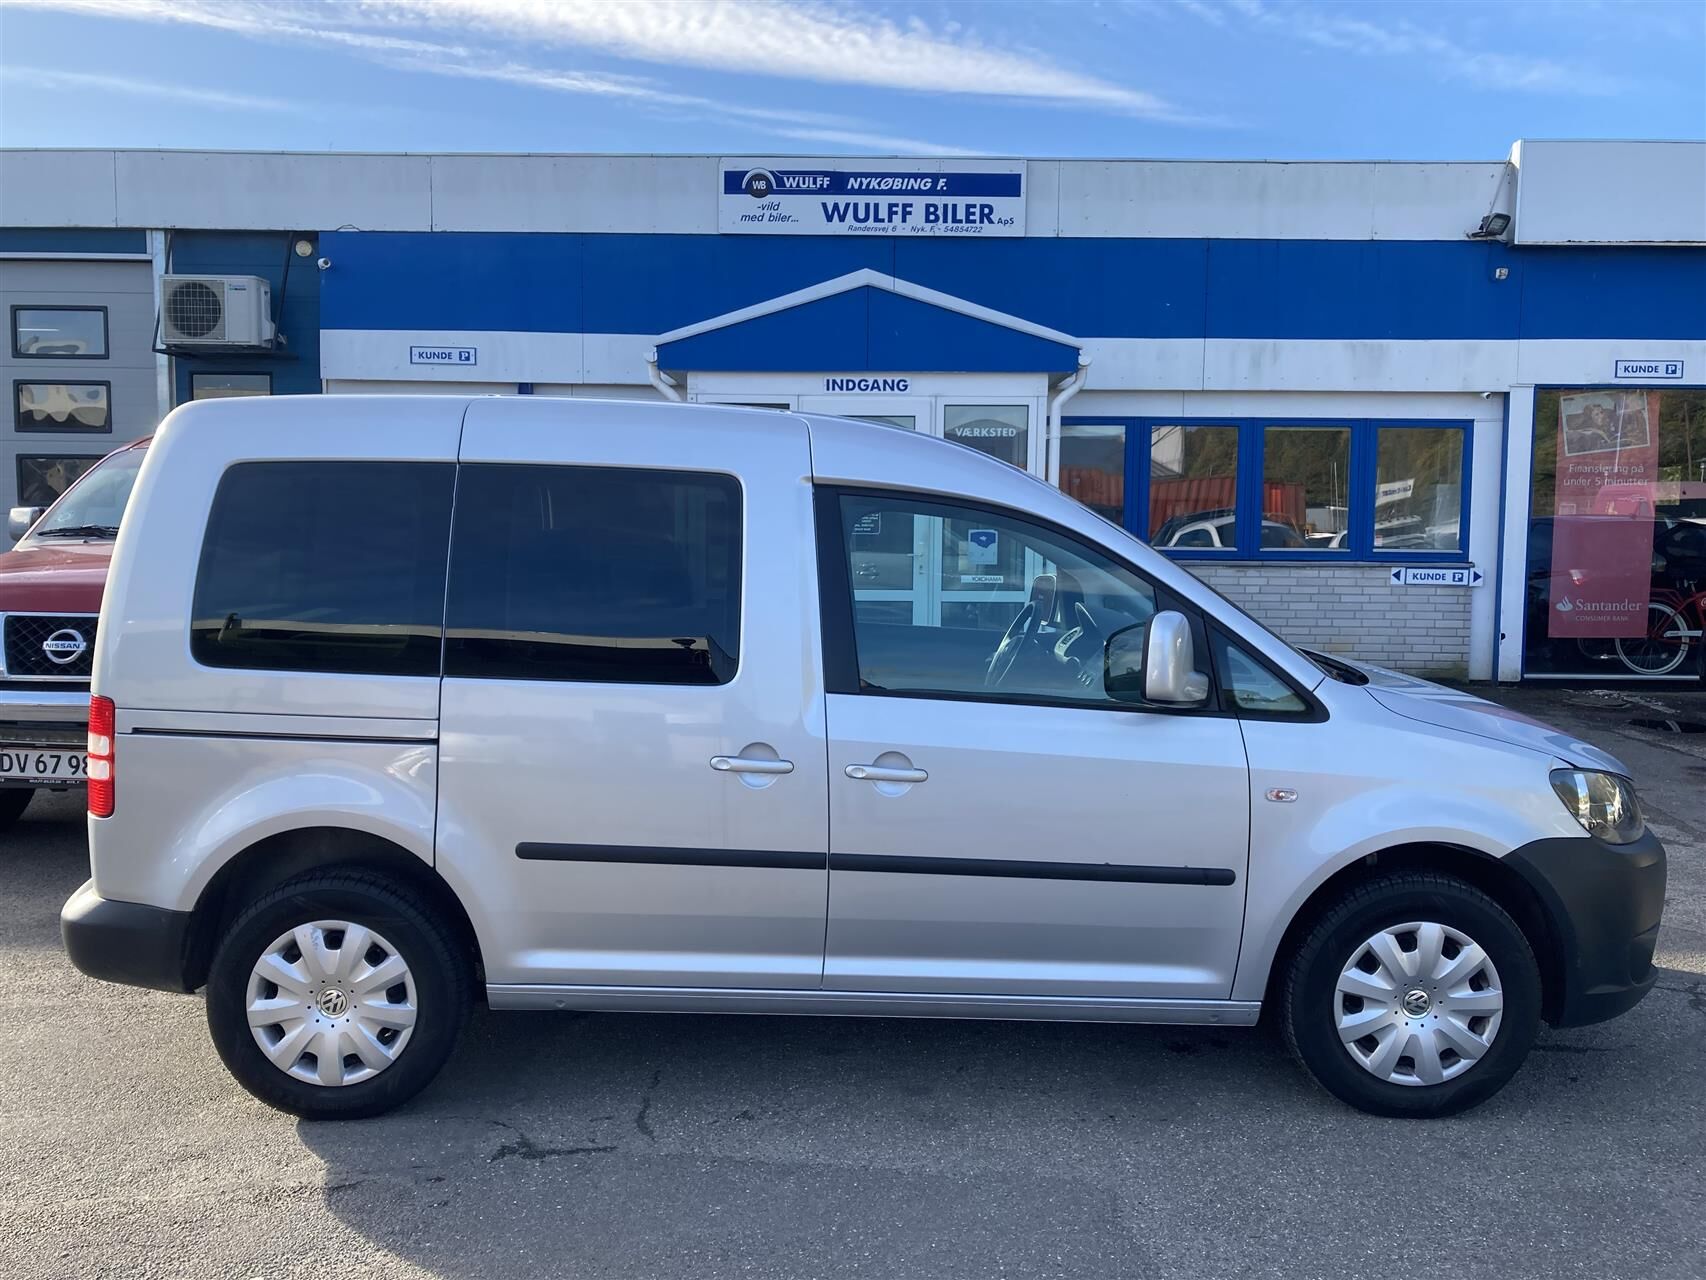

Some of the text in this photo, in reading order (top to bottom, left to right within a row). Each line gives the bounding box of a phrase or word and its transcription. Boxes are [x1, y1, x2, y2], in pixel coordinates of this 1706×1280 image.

[752, 180, 767, 190] WB
[783, 176, 831, 189] WULFF
[847, 177, 948, 191] NYKØBING F.
[757, 202, 780, 211] -vild
[740, 213, 765, 222] med
[821, 202, 1015, 227] WULFF BILER ApS
[847, 225, 888, 234] Randersvej
[891, 225, 897, 233] 6
[910, 226, 928, 234] Nyk.
[943, 226, 983, 234] 54854722
[418, 351, 453, 360] KUNDE
[1623, 365, 1660, 374] KUNDE
[825, 378, 909, 392] INDGANG
[955, 427, 1017, 437] VÆRKSTED
[1563, 477, 1591, 486] under
[1594, 477, 1601, 486] 5
[1412, 572, 1447, 581] KUNDE
[1575, 598, 1642, 611] Santander
[0, 753, 29, 773] DV
[35, 753, 62, 774] 67
